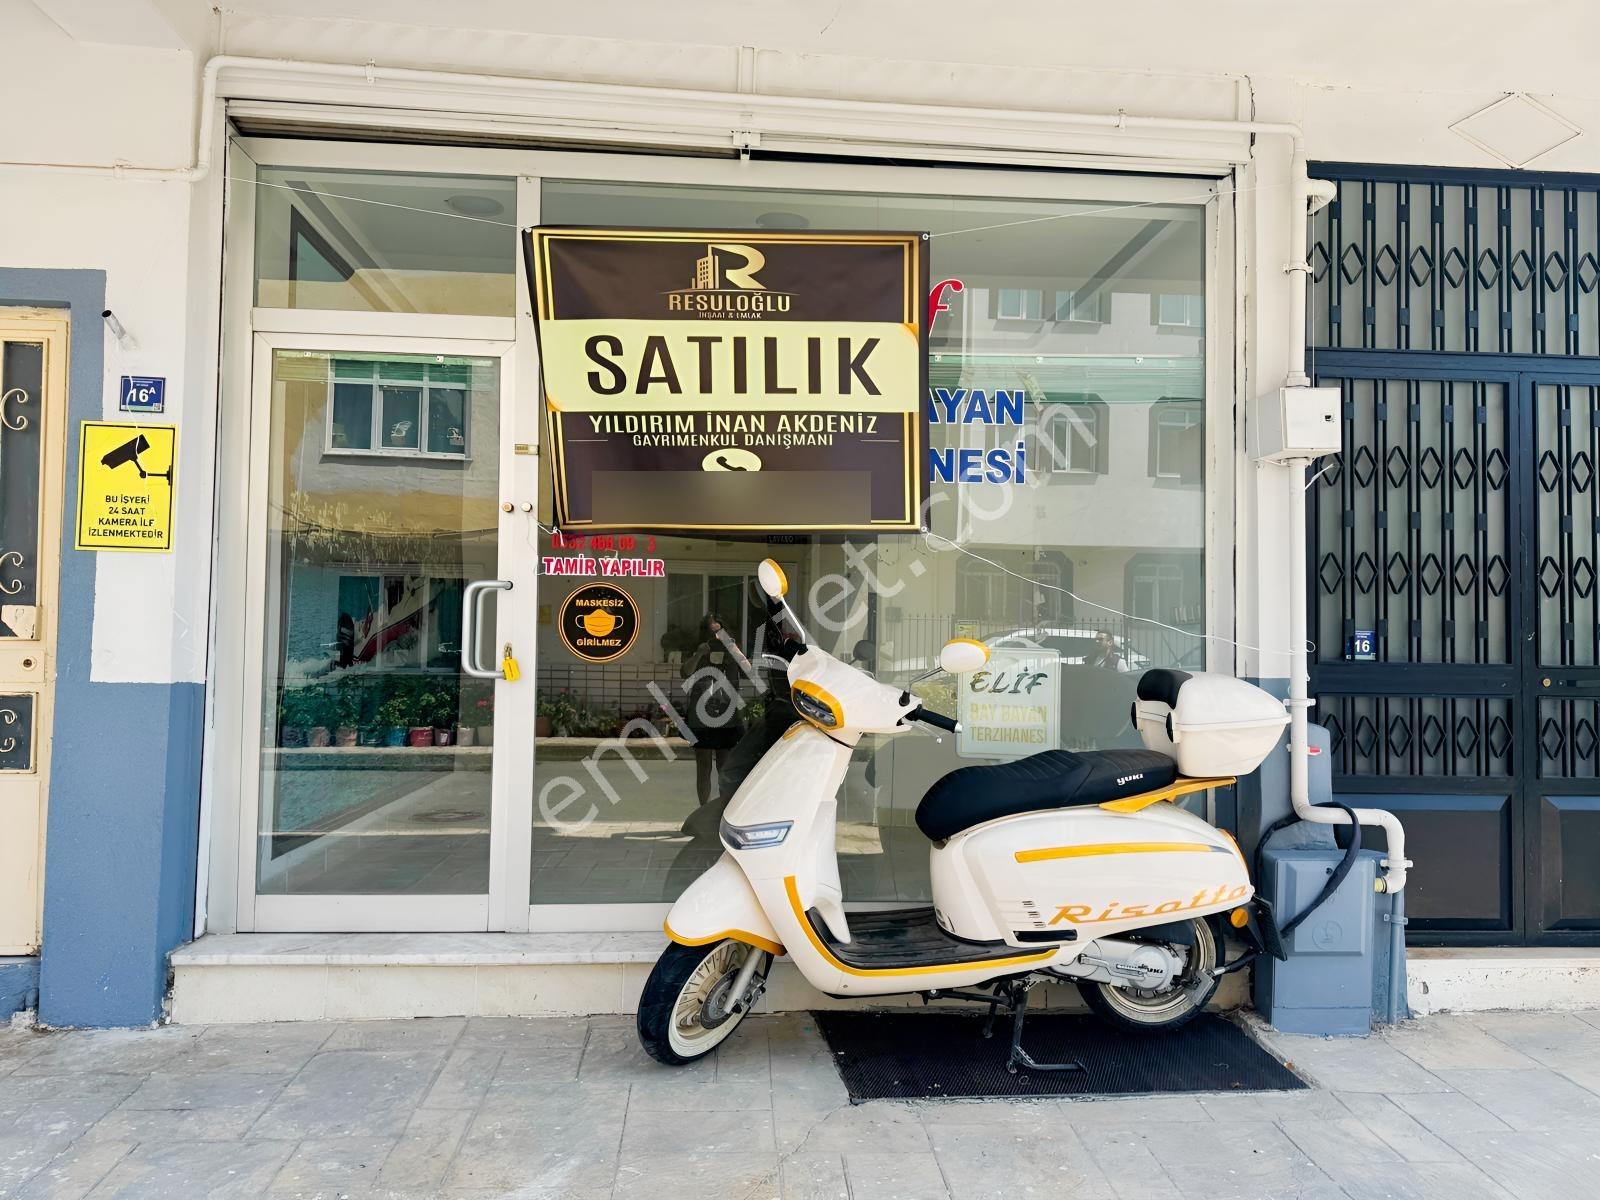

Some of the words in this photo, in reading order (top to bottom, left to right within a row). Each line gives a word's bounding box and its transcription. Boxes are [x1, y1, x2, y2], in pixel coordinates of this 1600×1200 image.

[668, 292, 791, 312] RESULOĞLU
[584, 334, 882, 396] SATILIK
[588, 414, 695, 434] YILDIRIM
[706, 411, 767, 433] İNAN
[777, 412, 878, 434] AKDENİZ
[633, 434, 739, 447] GAYRIMENKUL
[744, 434, 833, 449] DANIŞMANI
[105, 495, 118, 503] BU
[120, 493, 150, 504] İŞYERİ
[108, 506, 119, 515] 24
[121, 507, 146, 515] SAAT
[98, 517, 138, 526] KAMERA
[88, 527, 164, 539] İZLENMEKTEDİR
[542, 554, 597, 576] TAMİR
[599, 558, 665, 577] YAPILIR
[575, 598, 624, 607] MASKESİZ
[576, 637, 622, 646] GİRİLMEZ
[1355, 640, 1370, 653] 16
[969, 666, 1048, 695] ELİF
